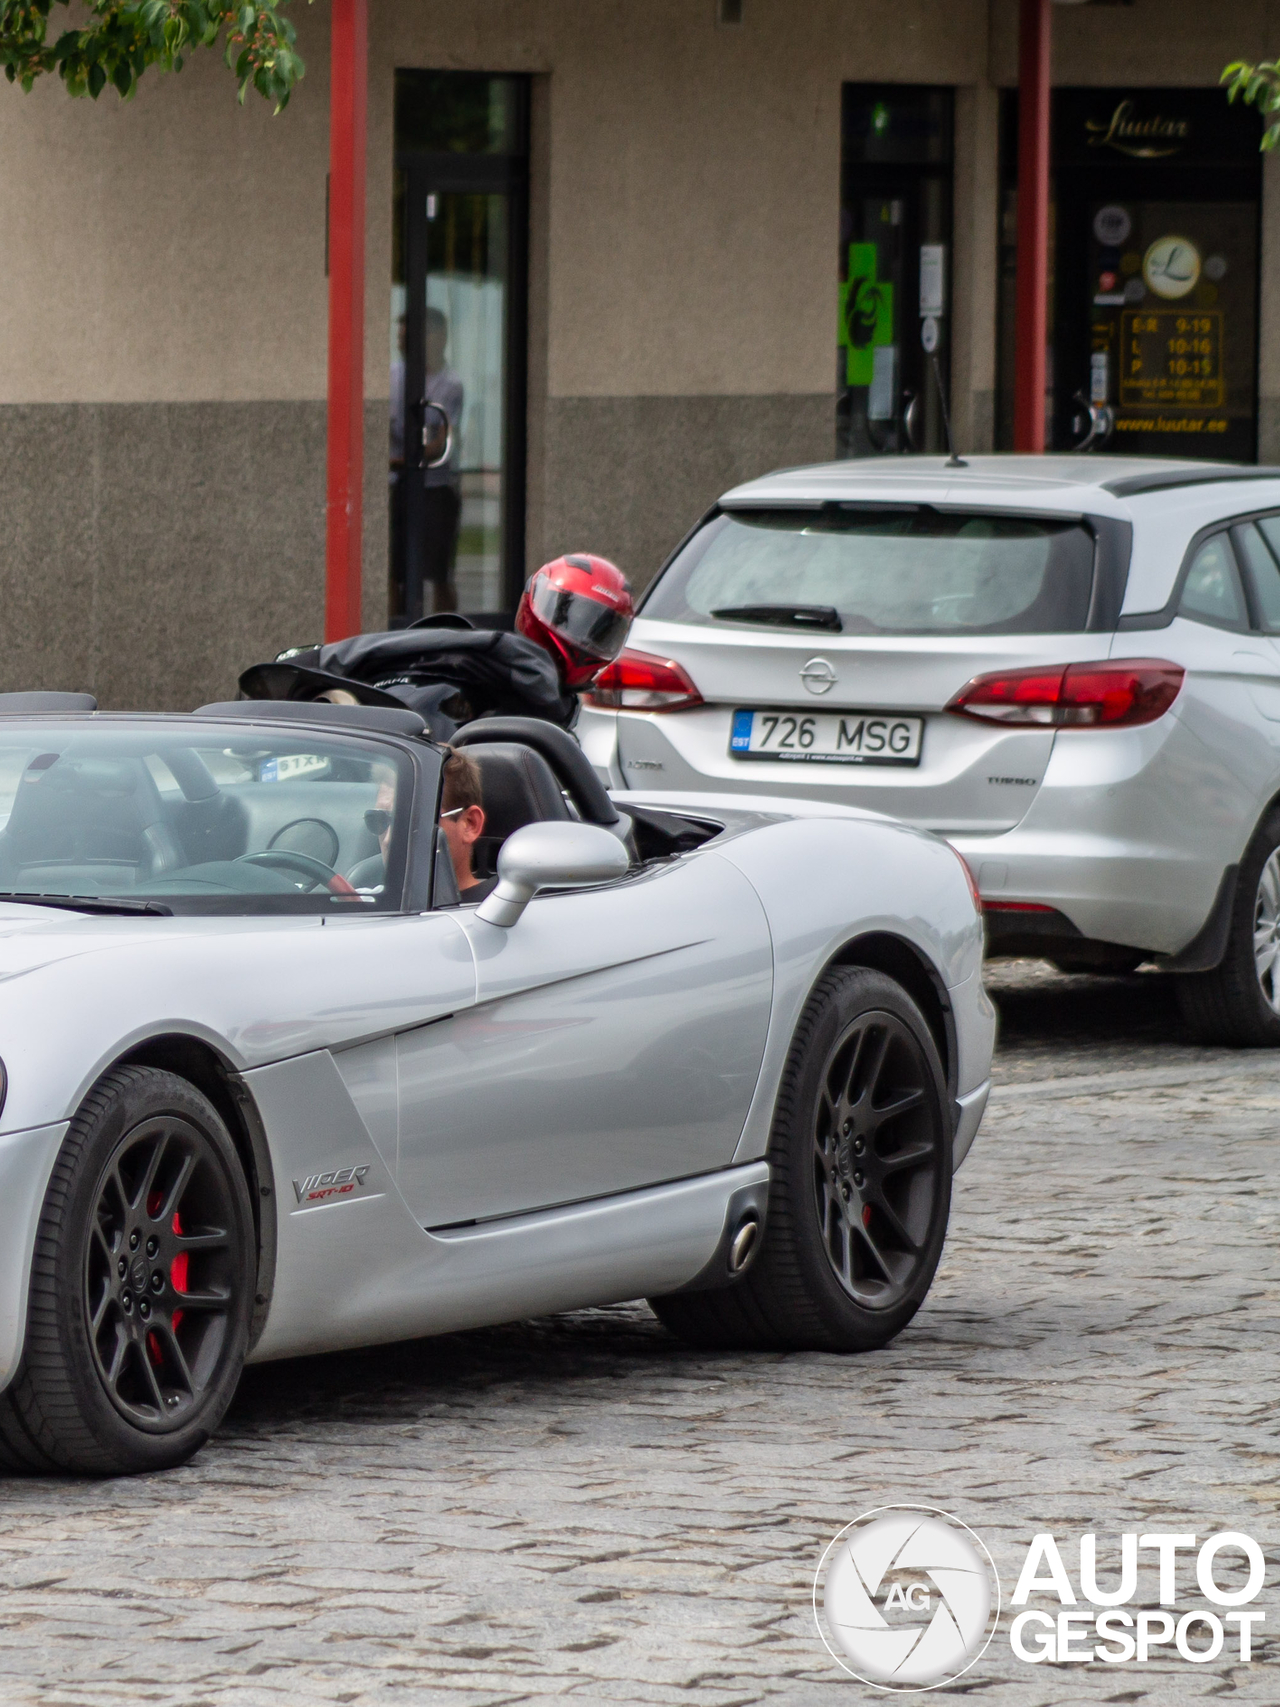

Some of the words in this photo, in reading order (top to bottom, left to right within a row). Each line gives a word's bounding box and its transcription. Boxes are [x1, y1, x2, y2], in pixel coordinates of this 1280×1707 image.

[1116, 416, 1227, 434] www.luutar.ee
[732, 737, 750, 748] EST
[759, 716, 817, 749] 726
[836, 719, 911, 754] MSG
[987, 776, 1037, 787] TURBO
[291, 1163, 372, 1205] VIPER
[306, 1183, 355, 1201] SRT-10
